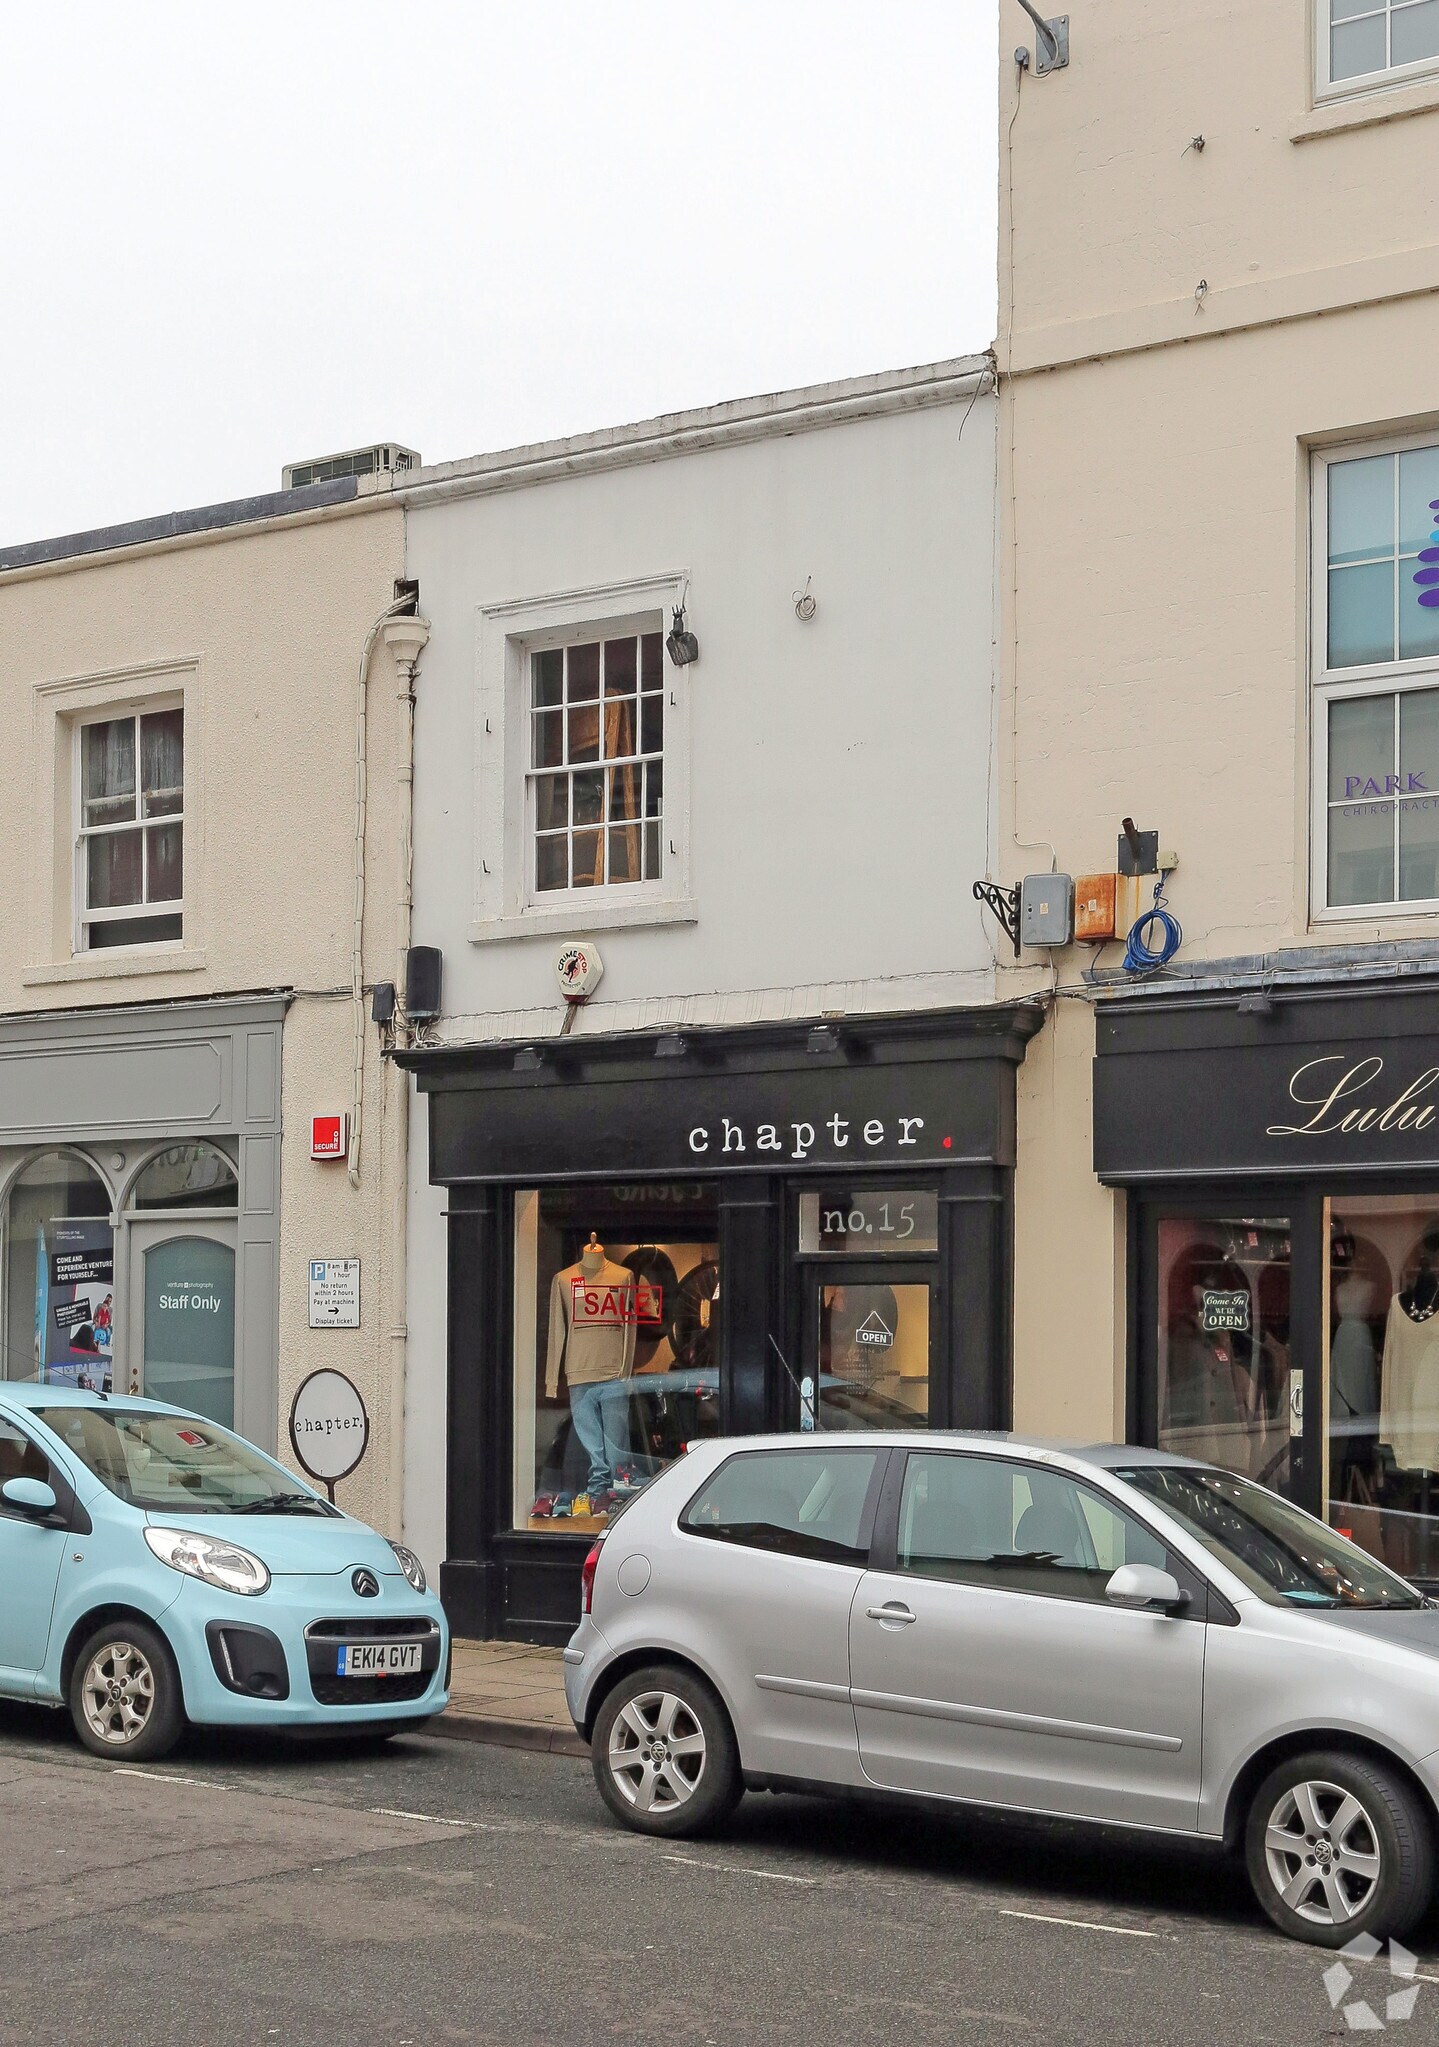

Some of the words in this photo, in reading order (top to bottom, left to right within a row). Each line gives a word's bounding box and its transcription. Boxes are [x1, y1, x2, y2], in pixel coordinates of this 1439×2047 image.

[1344, 771, 1428, 797] PARK
[1266, 1055, 1439, 1135] Lulu
[56, 1256, 72, 1264] COME
[57, 1263, 88, 1273] EXPERIENCE
[88, 1260, 113, 1269] VENTURE
[57, 1273, 69, 1281] FOR
[159, 1294, 189, 1309] Staff
[191, 1294, 222, 1313] Only
[313, 1298, 323, 1306] Pay
[584, 1292, 650, 1316] SALE
[1206, 1296, 1230, 1305] Come
[1231, 1296, 1245, 1305] In
[315, 1317, 336, 1325] Display
[1208, 1315, 1243, 1326] OPEN
[862, 1332, 887, 1343] OPEN
[295, 1417, 363, 1435] chapter.
[351, 1647, 386, 1669] EK14
[389, 1646, 417, 1667] GVT
